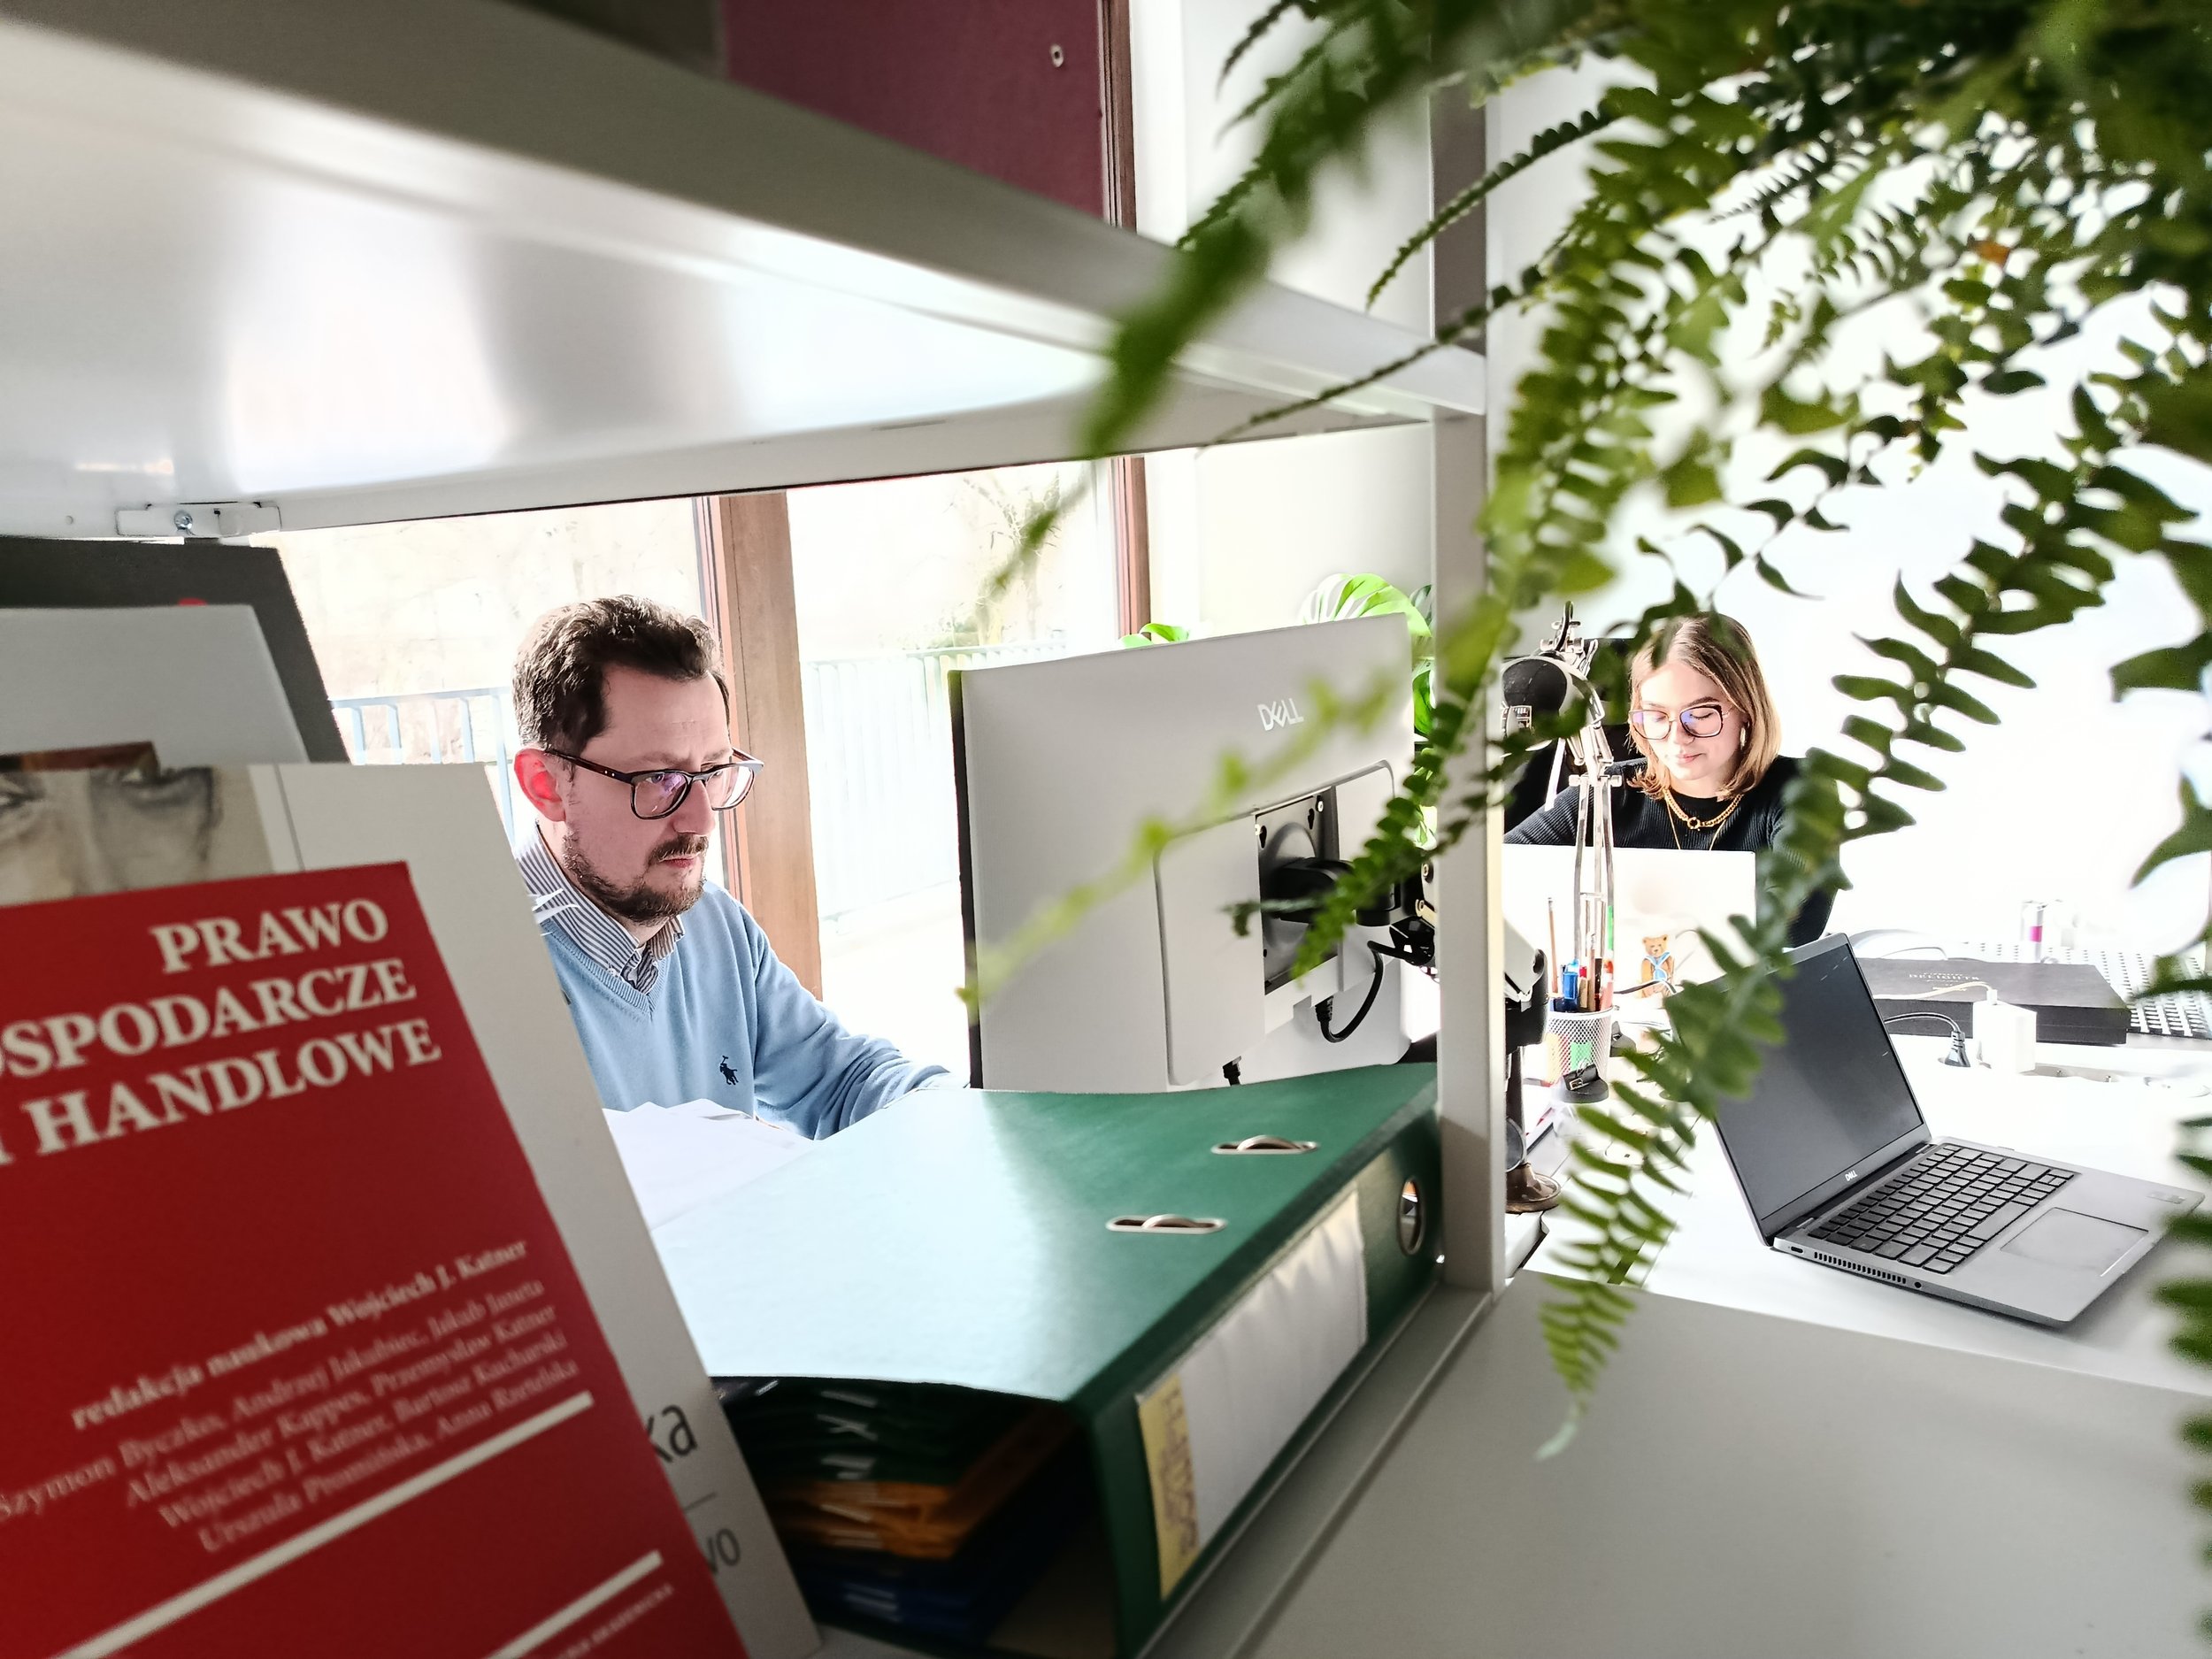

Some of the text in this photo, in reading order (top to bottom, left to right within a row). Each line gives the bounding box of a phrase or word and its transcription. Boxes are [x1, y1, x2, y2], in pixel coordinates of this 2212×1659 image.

[1256, 697, 1304, 732] DELL
[150, 899, 388, 974] PRAWO
[0, 958, 417, 1078] SPODARCZE
[19, 1018, 442, 1156] HANDLOWE
